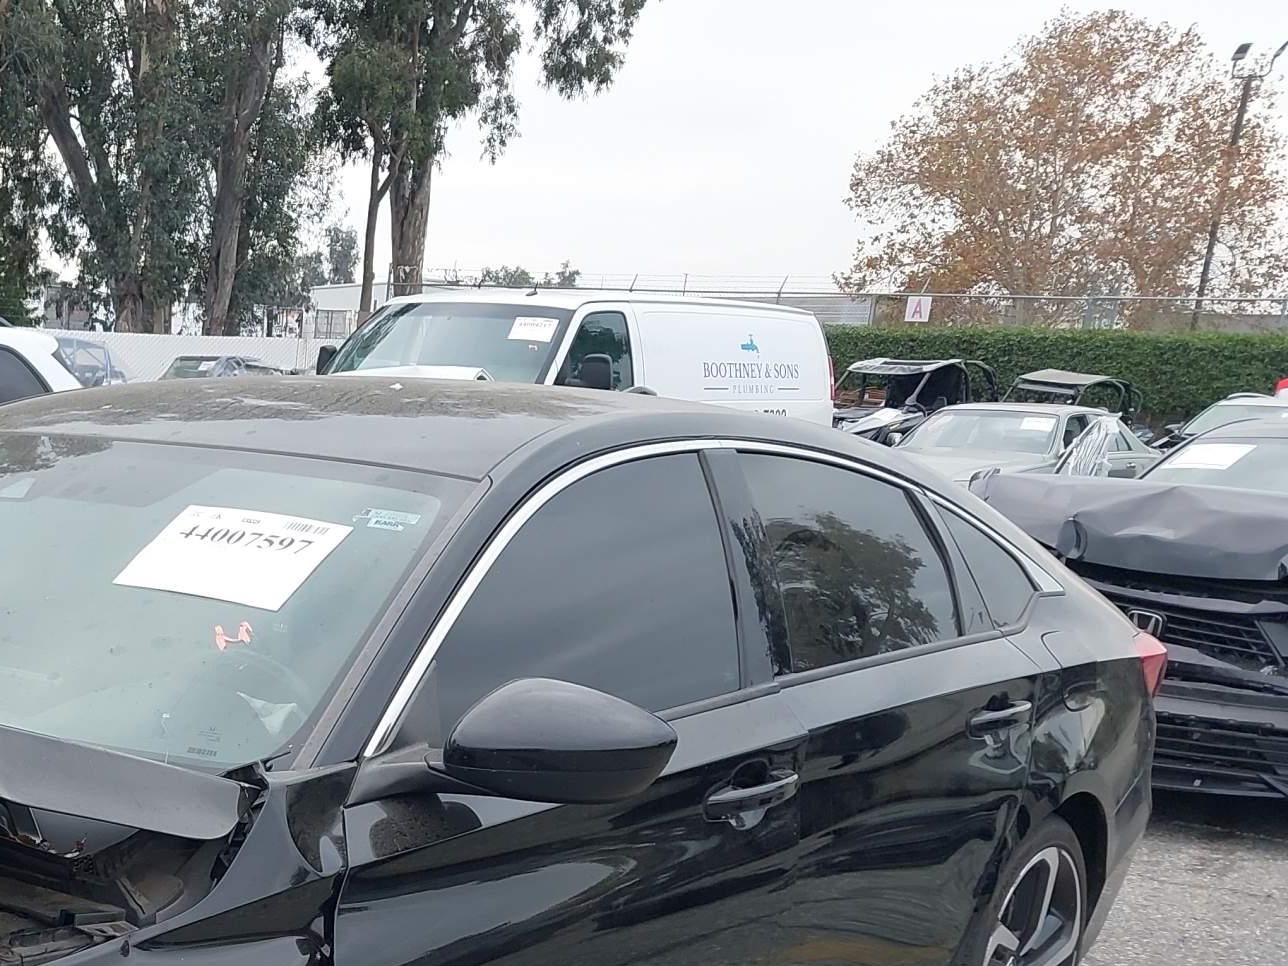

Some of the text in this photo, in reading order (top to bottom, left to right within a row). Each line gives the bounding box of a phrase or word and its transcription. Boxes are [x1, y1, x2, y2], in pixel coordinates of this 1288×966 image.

[911, 297, 923, 319] A
[703, 361, 800, 380] BOOTHNEY & SONS
[732, 384, 775, 394] PLUMBING
[179, 524, 316, 555] 44007597
